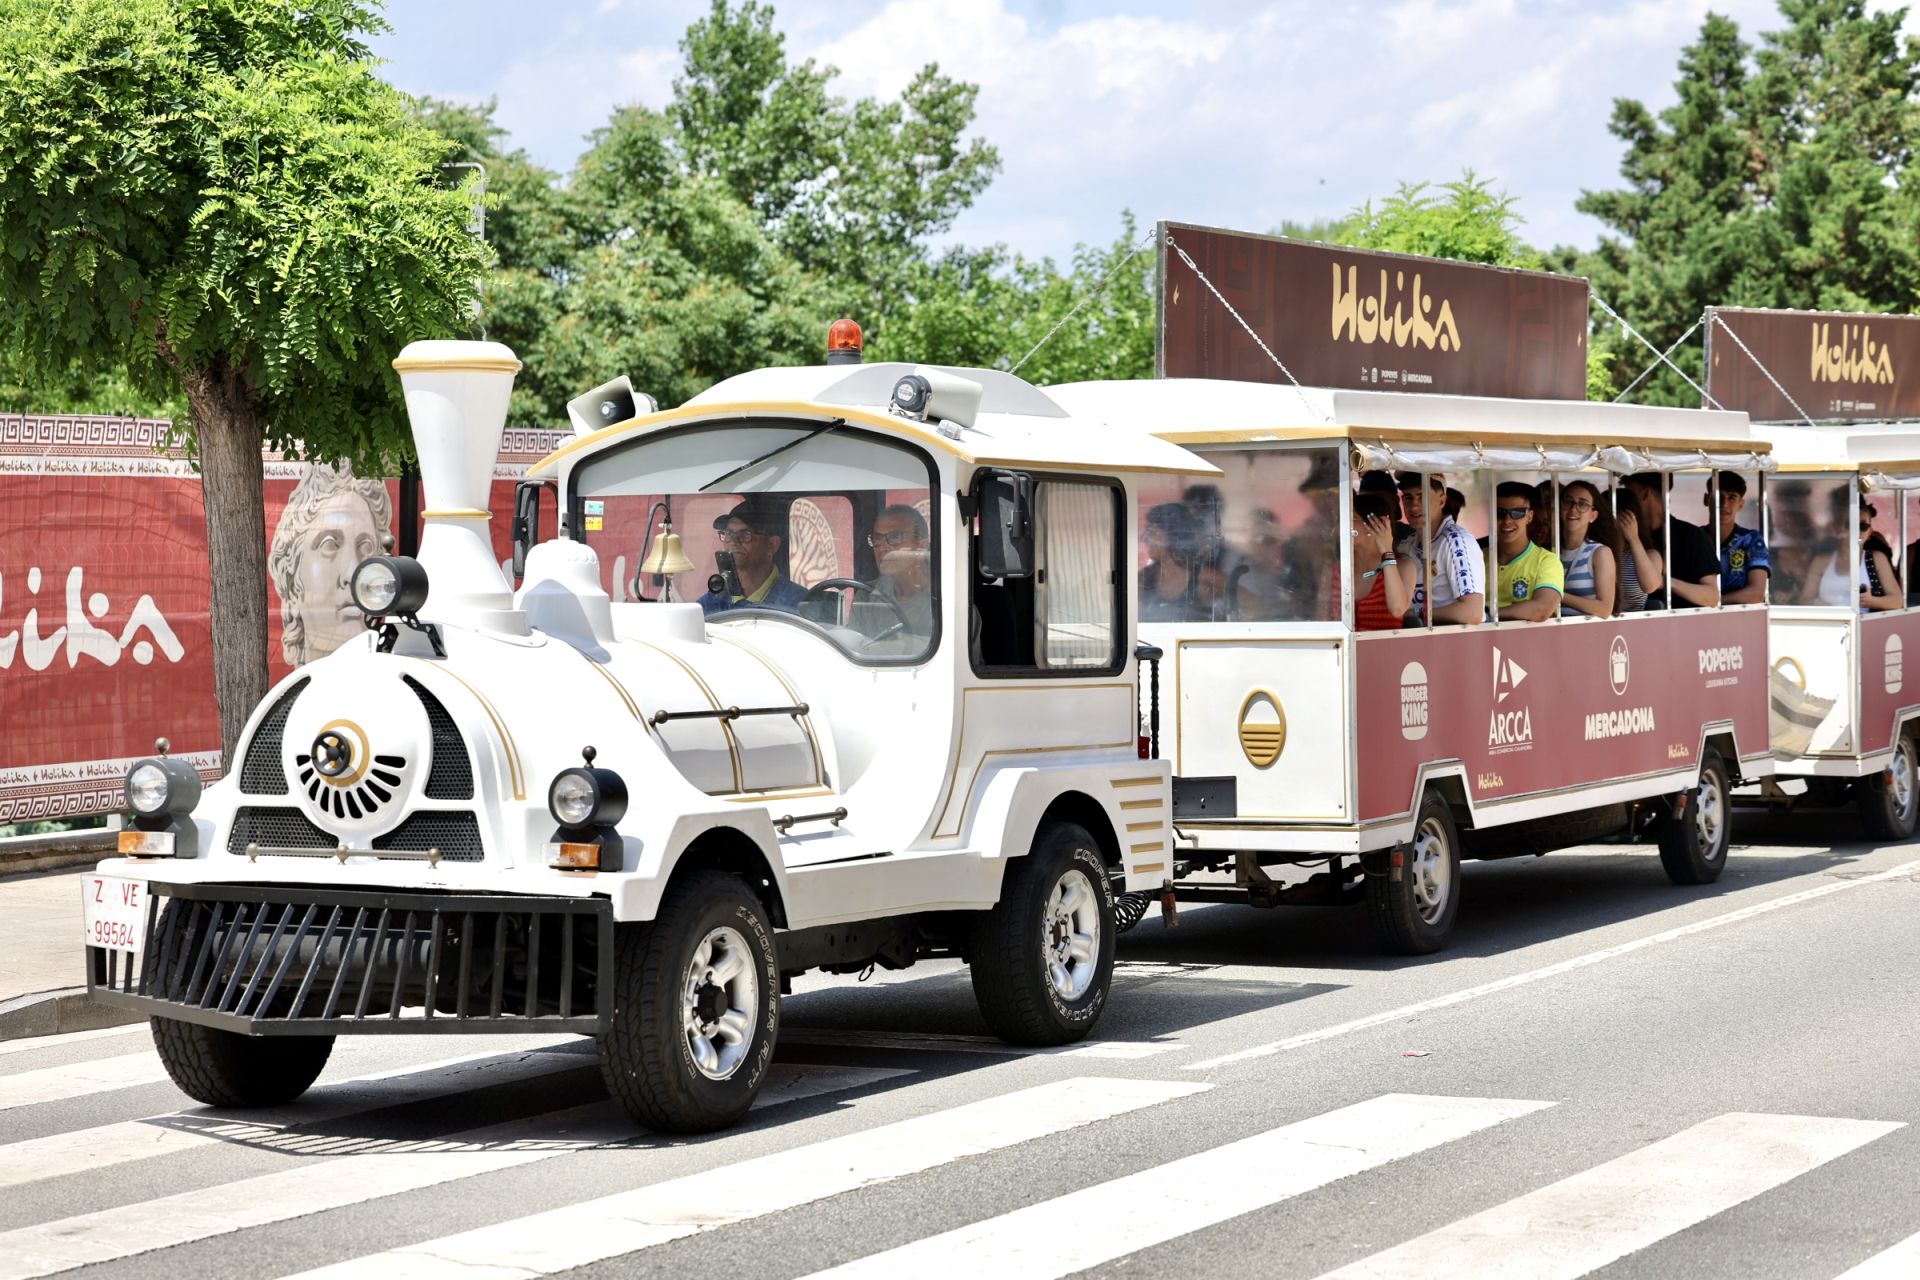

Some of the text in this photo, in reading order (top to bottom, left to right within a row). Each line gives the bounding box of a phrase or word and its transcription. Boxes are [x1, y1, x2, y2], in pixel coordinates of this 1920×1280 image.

[1332, 262, 1461, 352] Holika
[1811, 322, 1895, 385] Holika
[44, 460, 79, 472] Holika
[90, 461, 126, 473] Holika
[137, 462, 169, 474] Holika
[264, 465, 296, 476] Holika
[1401, 685, 1428, 703] BURGER
[1402, 701, 1428, 727] KING
[1488, 704, 1533, 746] ARCCA
[1584, 706, 1655, 741] MERCADONA
[0, 770, 30, 784] olika
[41, 767, 76, 781] Holika
[87, 763, 121, 777] Holika
[1074, 848, 1113, 908] COOPER
[94, 879, 140, 907] Z VE
[95, 920, 134, 947] 99584
